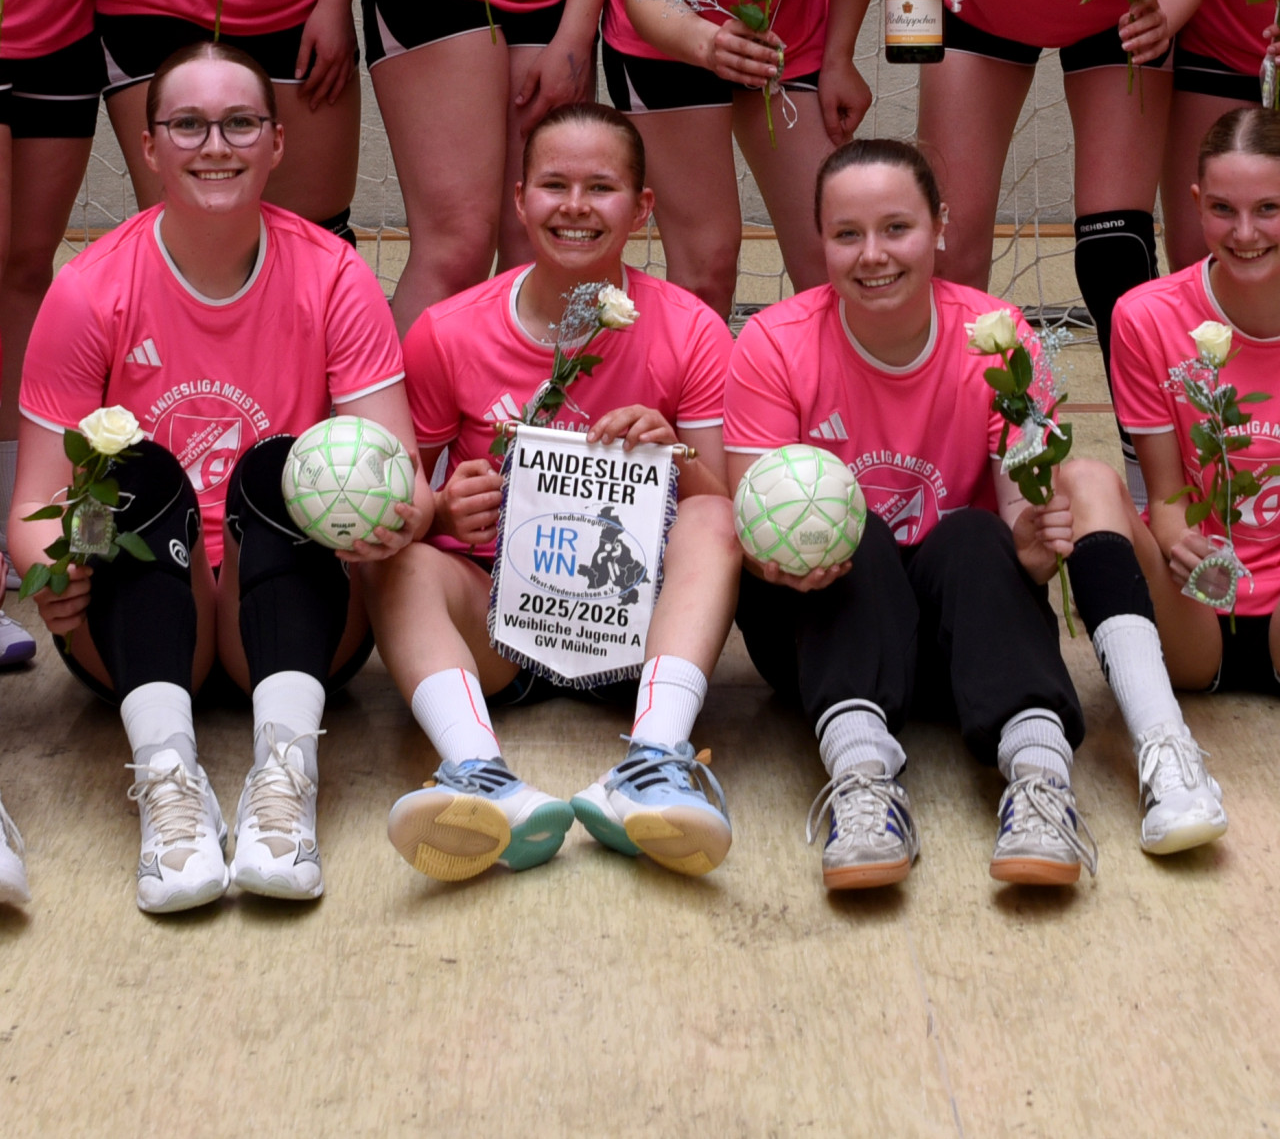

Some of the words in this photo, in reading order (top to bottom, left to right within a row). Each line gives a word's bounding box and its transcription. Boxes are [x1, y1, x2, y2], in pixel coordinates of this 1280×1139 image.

[144, 379, 270, 431] LANDESLIGAMEISTER
[519, 447, 660, 487] LANDESLIGA
[847, 449, 948, 499] DESLIGAMEISTER
[537, 472, 636, 506] MEISTER
[535, 524, 579, 552] HR
[552, 513, 608, 529] Handballregion
[533, 549, 577, 578] WN
[530, 573, 602, 598] West-Niedersachsen
[518, 592, 630, 628] 2025/2026
[504, 613, 572, 637] Weibliche
[576, 625, 627, 645] Jugend
[630, 633, 642, 647] A
[534, 634, 558, 649] GW
[561, 639, 608, 657] Mühlen
